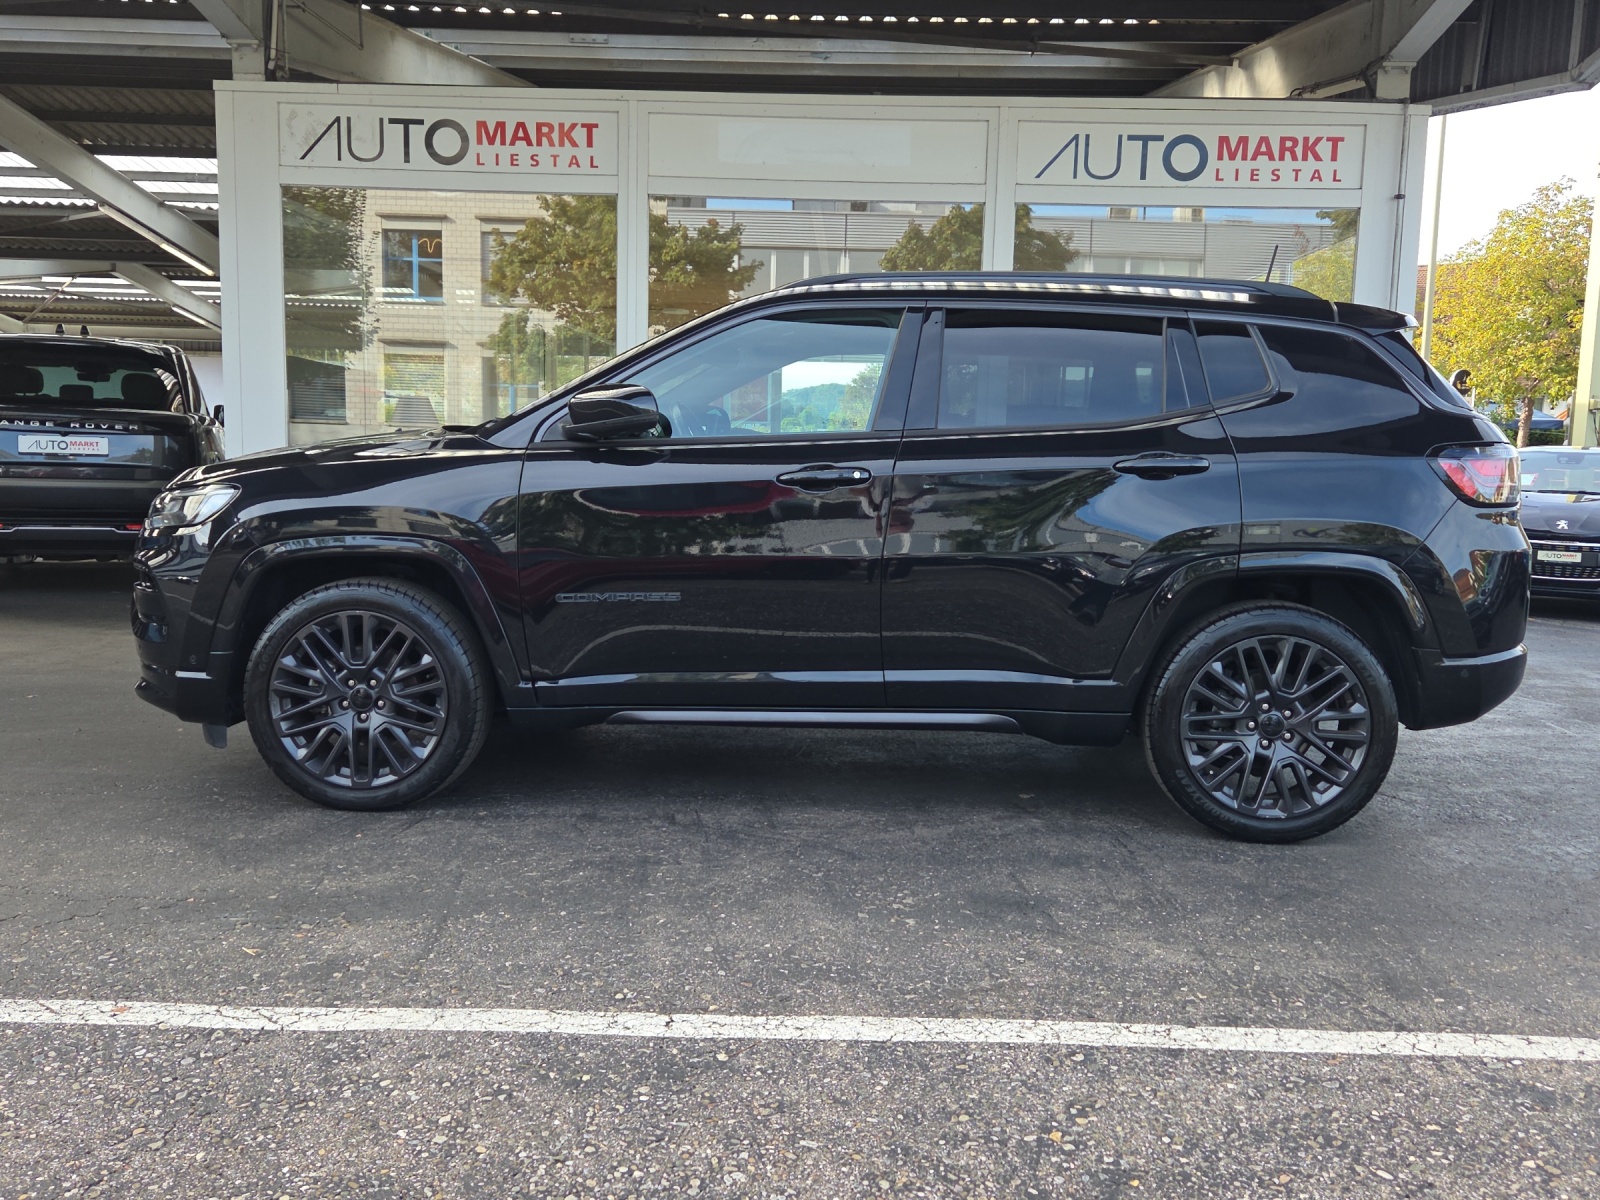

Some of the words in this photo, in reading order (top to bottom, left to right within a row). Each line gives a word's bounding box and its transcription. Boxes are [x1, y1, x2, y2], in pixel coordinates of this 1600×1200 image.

[299, 115, 470, 166] AUTO
[475, 120, 599, 148] MARKT
[476, 152, 599, 169] LIESTAL
[1034, 133, 1209, 182] AUTO
[1216, 135, 1345, 162] MARKT
[1215, 168, 1342, 182] LIESTAL
[0, 419, 55, 427] ANGE
[70, 422, 138, 430] ROVER
[27, 439, 69, 451] AUTO
[69, 440, 100, 448] MARKT
[555, 592, 681, 603] COMPASS
[1175, 769, 1238, 825] GOODYEAR
